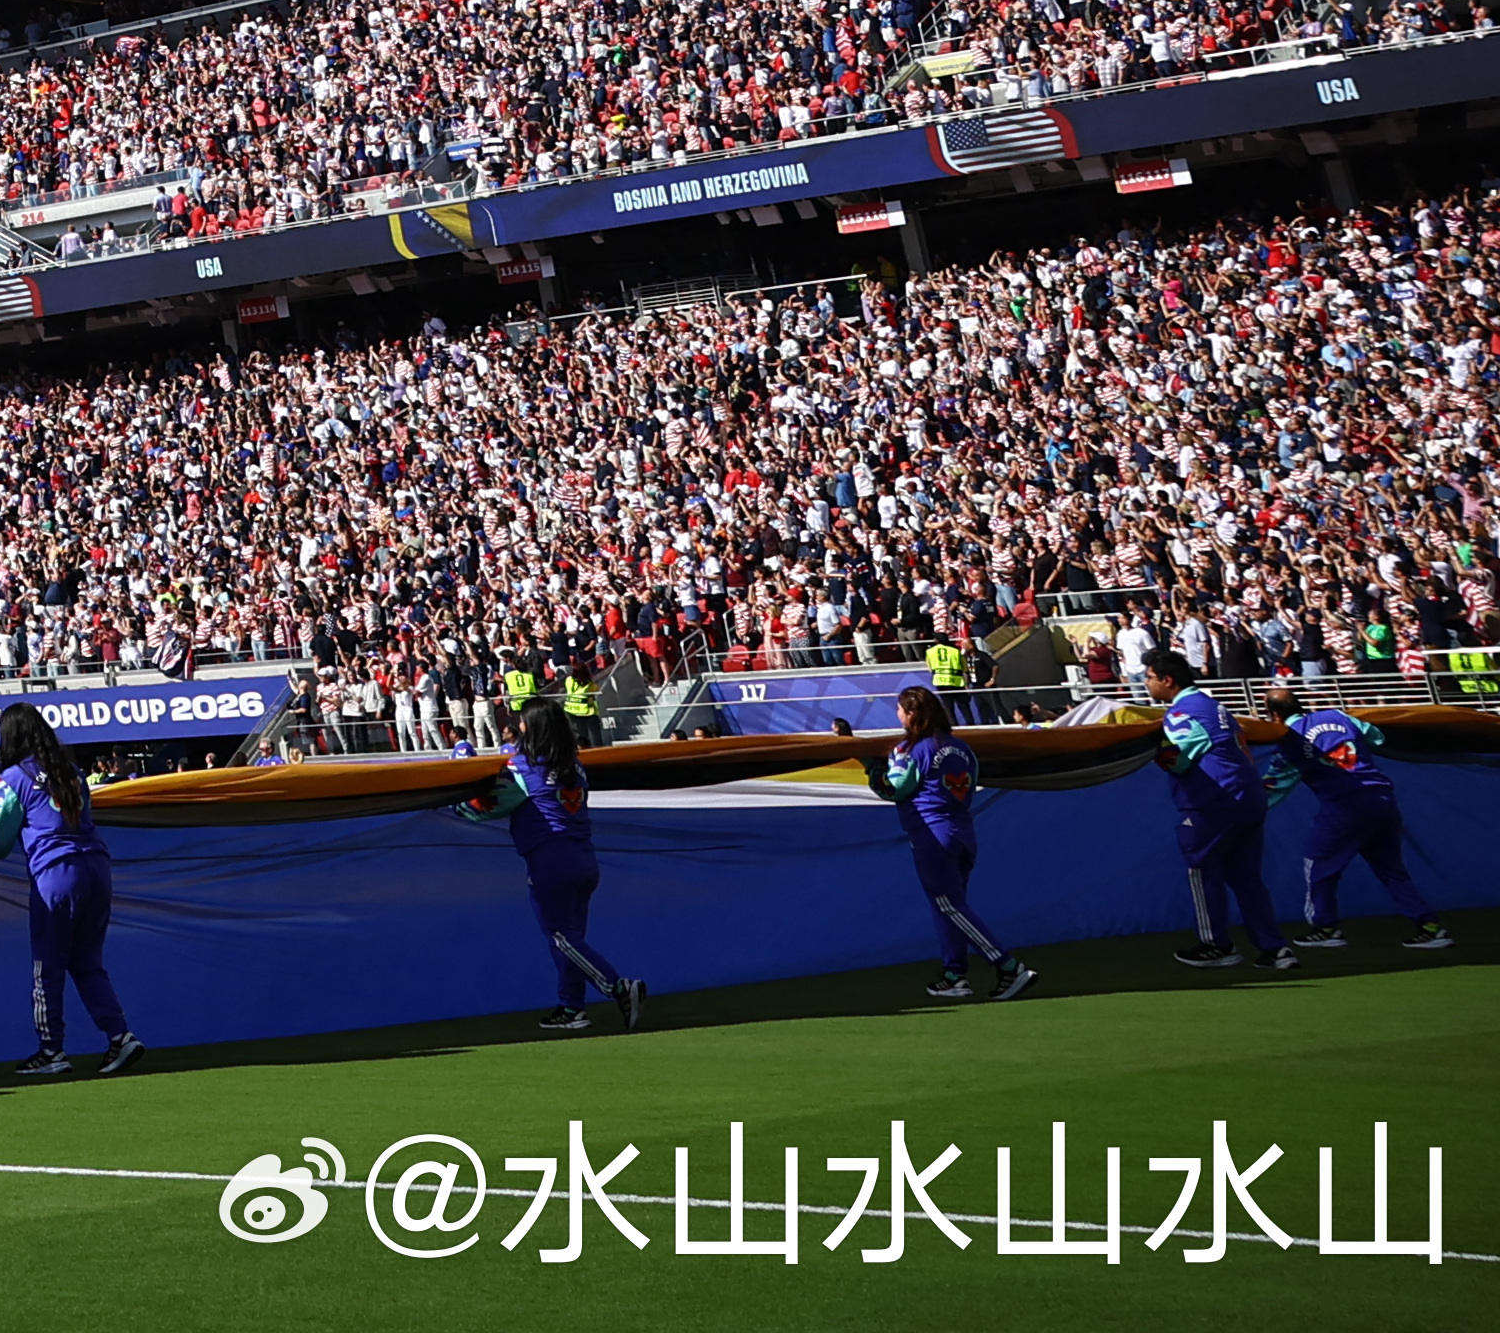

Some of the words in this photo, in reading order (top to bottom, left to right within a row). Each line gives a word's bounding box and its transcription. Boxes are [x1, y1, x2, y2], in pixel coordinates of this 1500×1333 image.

[1317, 78, 1359, 104] USA
[614, 185, 668, 212] BOSNIA
[671, 180, 702, 204] AND
[703, 163, 809, 198] HERZEGOVINA
[21, 211, 45, 225] 214
[196, 257, 222, 278] USA
[500, 266, 520, 276] 114
[521, 263, 540, 273] 115
[241, 307, 258, 316] 113
[259, 304, 276, 314] 114
[739, 684, 766, 702] 117
[114, 699, 165, 724] CUP
[169, 693, 265, 721] 2026
